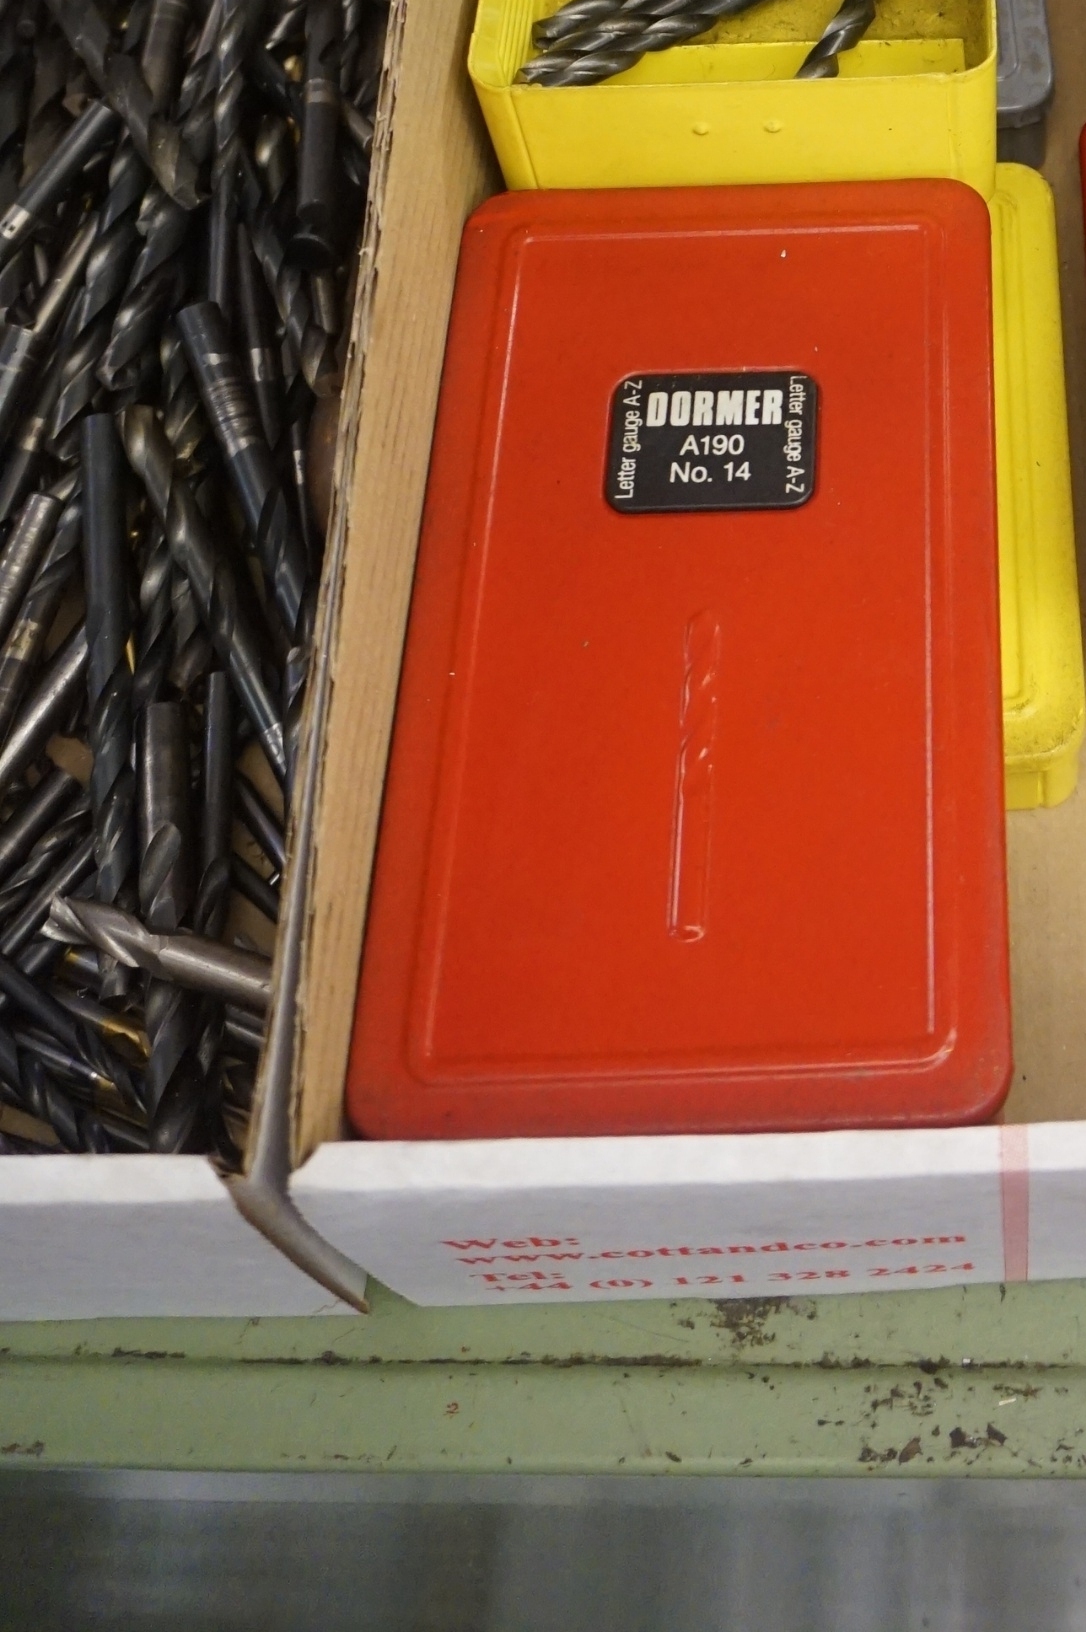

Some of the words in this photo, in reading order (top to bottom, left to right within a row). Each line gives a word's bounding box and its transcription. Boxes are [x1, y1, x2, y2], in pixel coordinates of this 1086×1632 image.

[622, 379, 643, 407] A-Z
[788, 375, 807, 415] Letter
[645, 389, 784, 427] DORMER
[622, 410, 643, 452] gauge
[679, 434, 745, 456] A190
[783, 419, 803, 462] gauge
[614, 457, 637, 499] Letter
[669, 461, 713, 483] No.
[723, 461, 752, 482] 14
[785, 465, 805, 494] A-Z
[439, 1237, 580, 1250] Web:
[456, 1235, 966, 1265] www.cottandco.com
[468, 1271, 565, 1283] Tel:
[485, 1282, 573, 1291] +44
[589, 1278, 653, 1290] (0)
[673, 1274, 745, 1285] 121
[767, 1270, 850, 1282] 328
[868, 1262, 975, 1277] 2424
